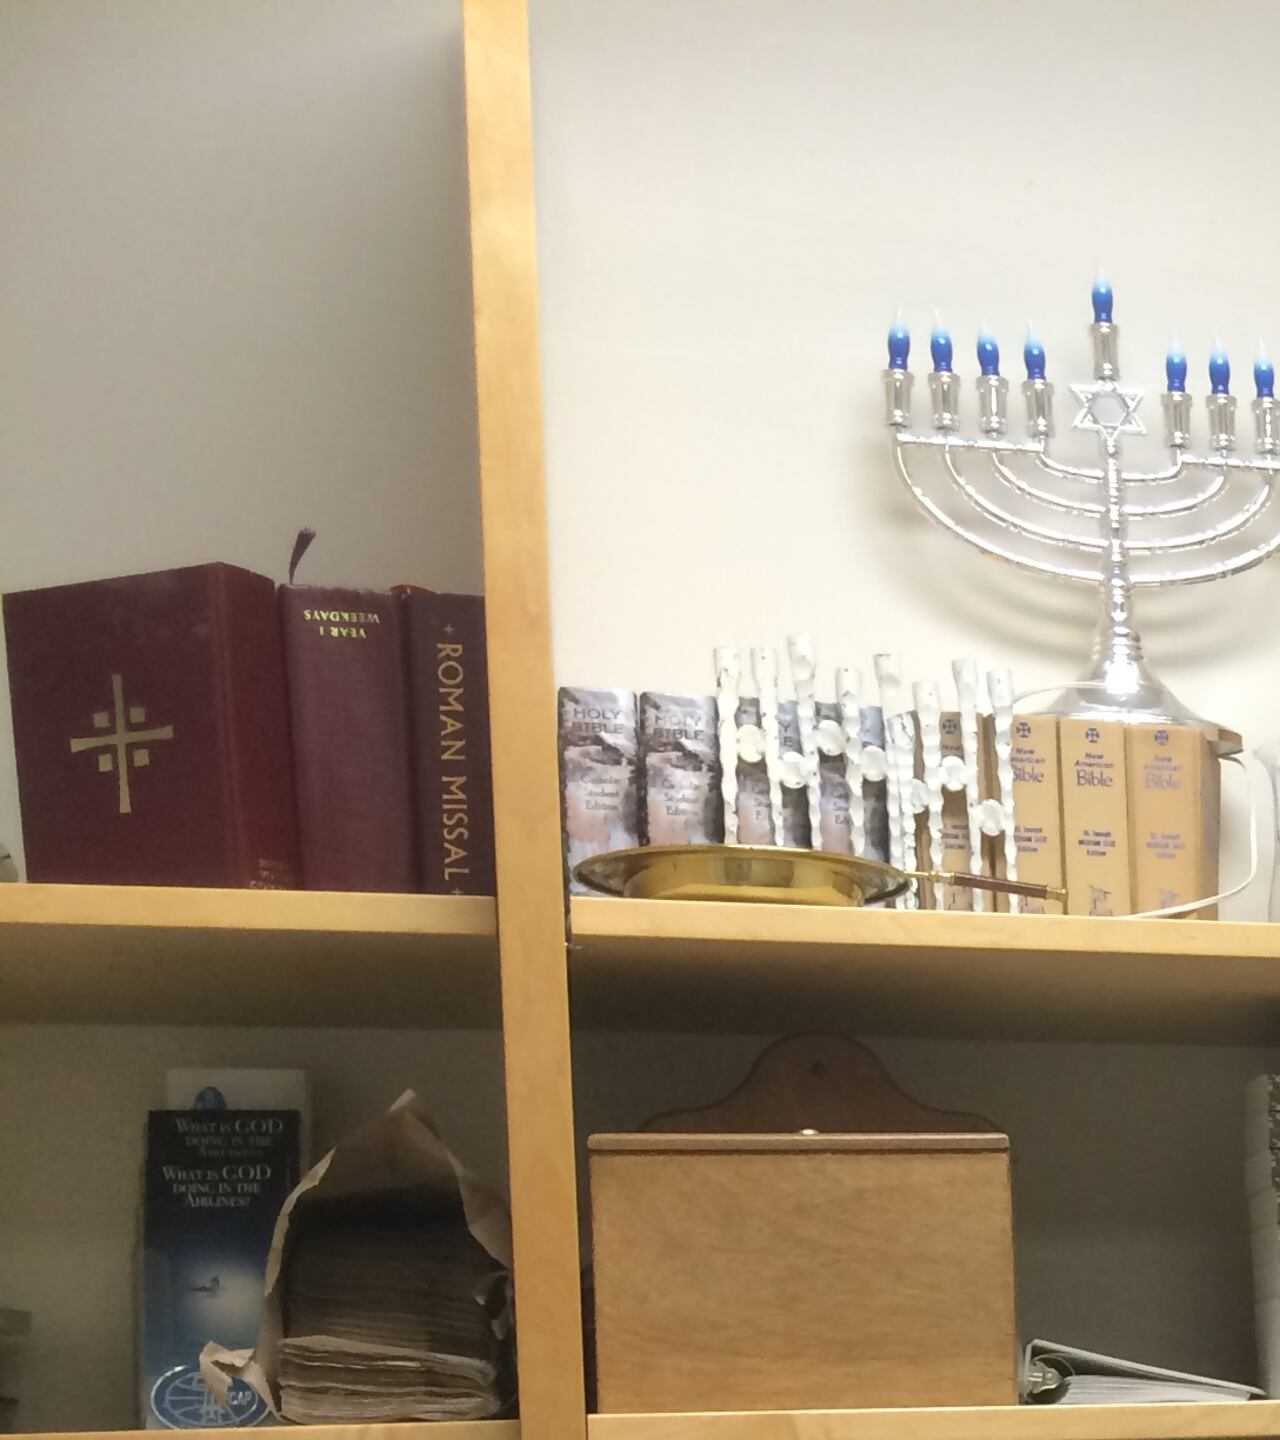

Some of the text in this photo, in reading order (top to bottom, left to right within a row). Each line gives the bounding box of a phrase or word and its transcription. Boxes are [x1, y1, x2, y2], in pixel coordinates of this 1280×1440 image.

[304, 609, 379, 623] WEEKDAYS
[331, 627, 366, 638] YEAR
[573, 708, 621, 720] HOLY
[654, 714, 702, 727] HOLY
[571, 722, 624, 734] BIBLE
[653, 728, 705, 740] BIBLE
[436, 643, 470, 880] ROMAN MISSAL
[1011, 757, 1046, 765] merican
[1012, 765, 1045, 783] Bible
[1076, 771, 1113, 787] Bible
[234, 1118, 283, 1133] GOD
[222, 1164, 272, 1180] GOD
